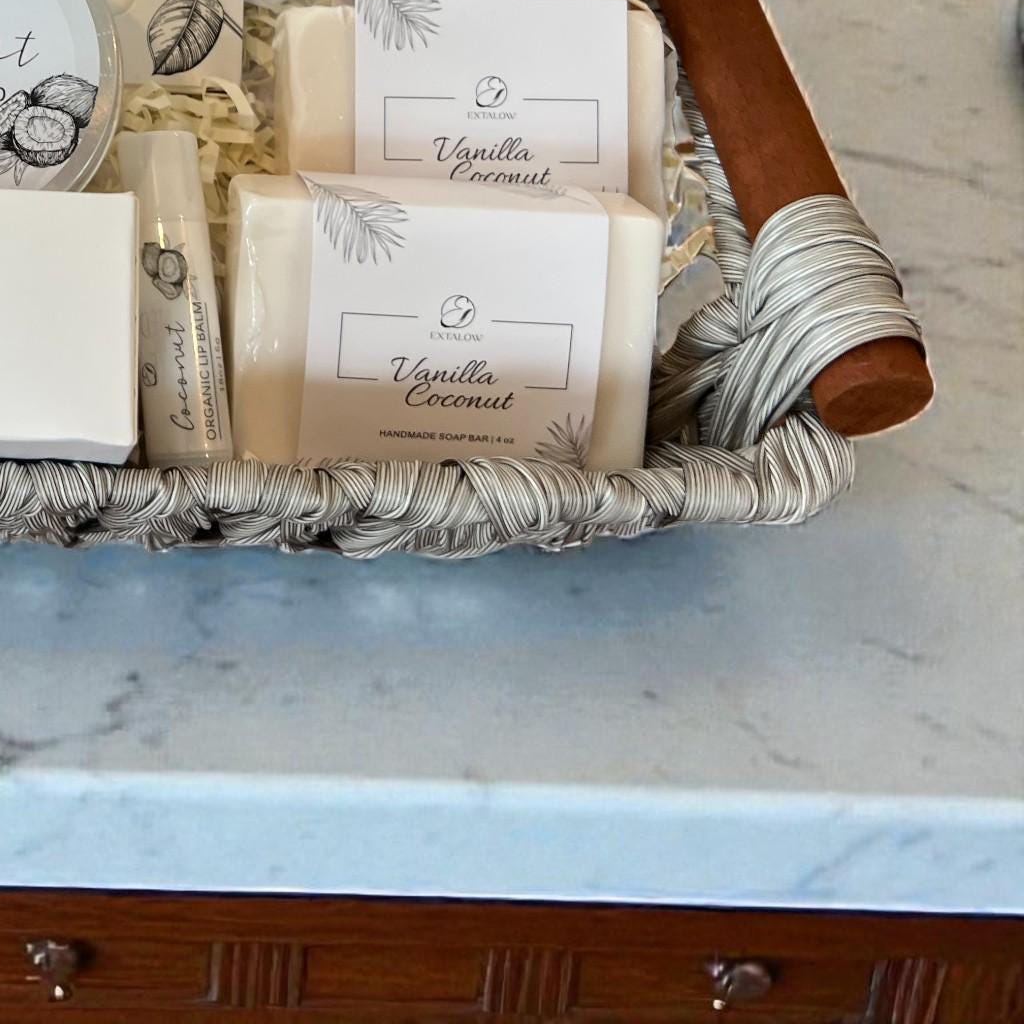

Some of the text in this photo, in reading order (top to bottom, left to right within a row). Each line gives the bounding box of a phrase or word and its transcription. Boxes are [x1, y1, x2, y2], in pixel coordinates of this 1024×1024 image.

[466, 111, 517, 120] EXTALOW
[433, 136, 535, 162] Vanilla
[429, 332, 483, 343] EXTALOW
[164, 321, 194, 431] Coconut
[192, 301, 216, 440] ORGANIC LIP BALM
[391, 357, 499, 386] Vanilla
[405, 382, 515, 410] Coconut
[379, 429, 436, 440] HANDMADE
[438, 432, 467, 441] SOAP
[468, 434, 489, 443] BAR
[503, 437, 515, 445] oz
